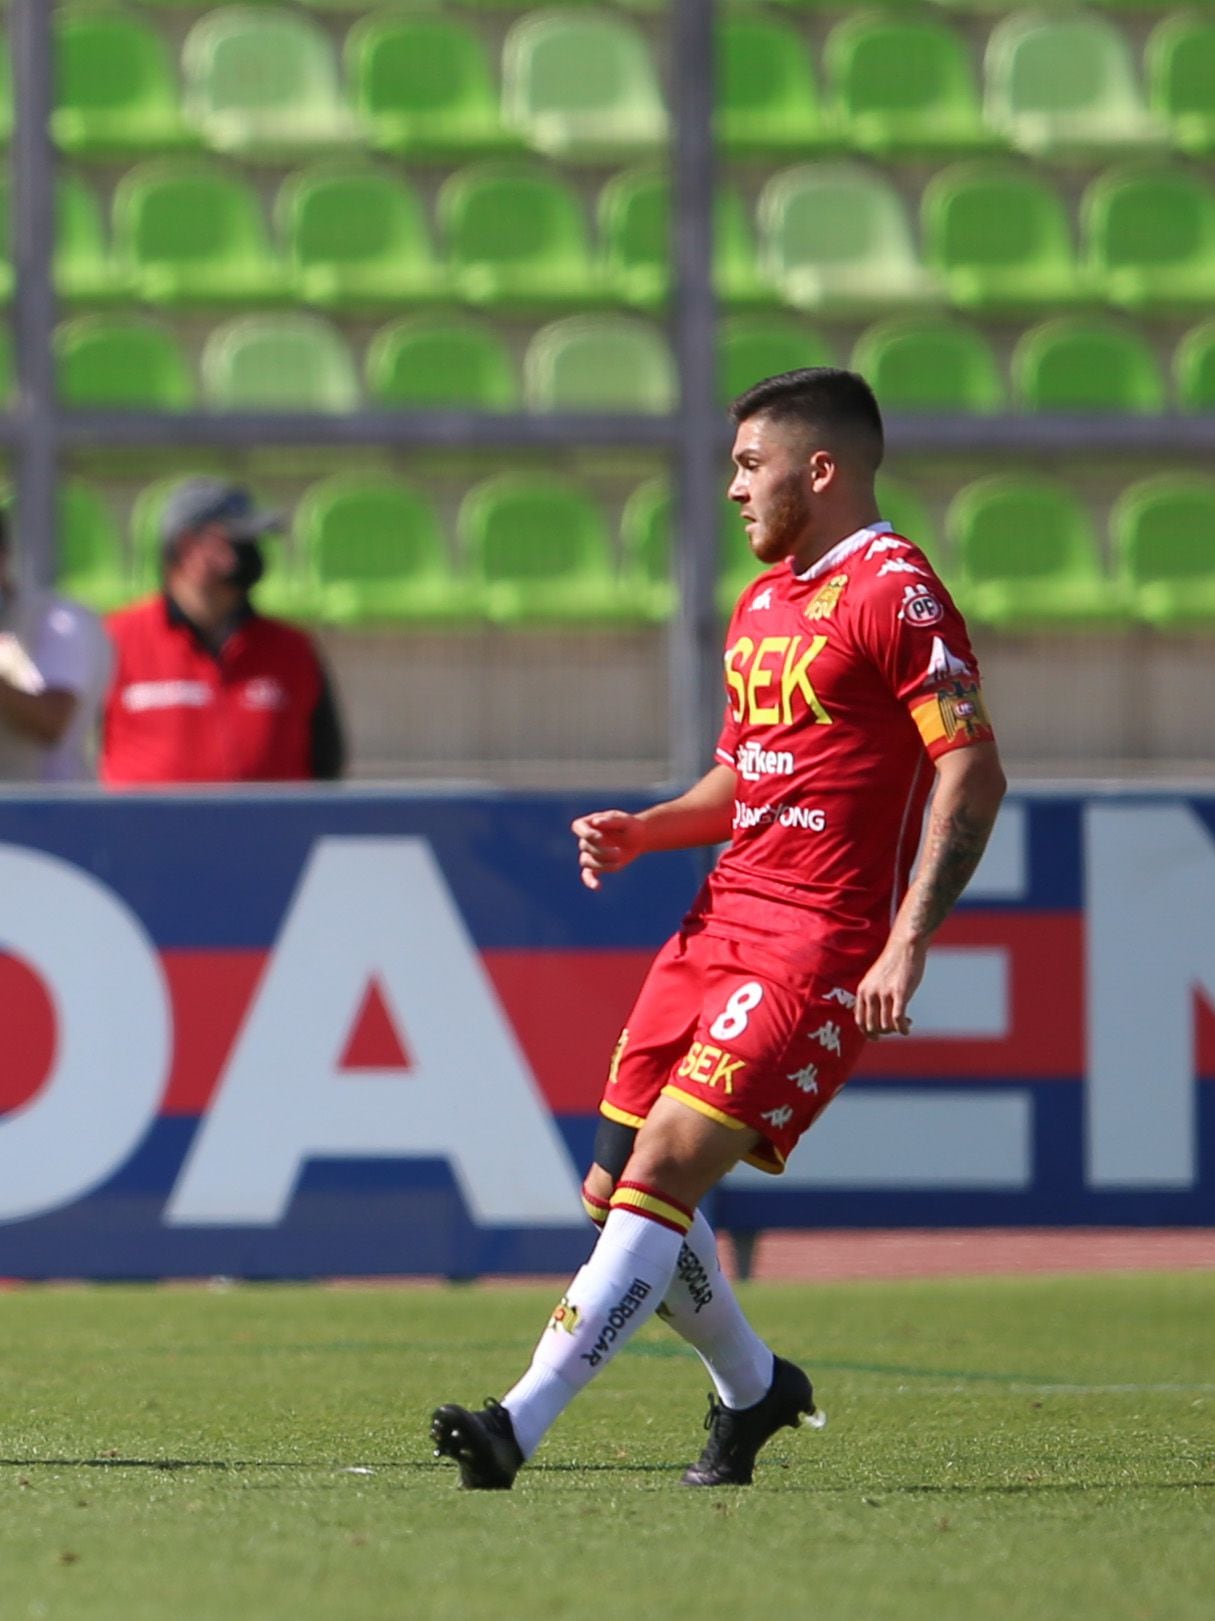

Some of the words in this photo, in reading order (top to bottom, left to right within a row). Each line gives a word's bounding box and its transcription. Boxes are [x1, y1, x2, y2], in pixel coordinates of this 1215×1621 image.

[724, 635, 833, 725] SEK
[709, 981, 764, 1041] 8
[678, 1041, 747, 1095] SEK
[580, 1277, 652, 1367] IBEROCAR
